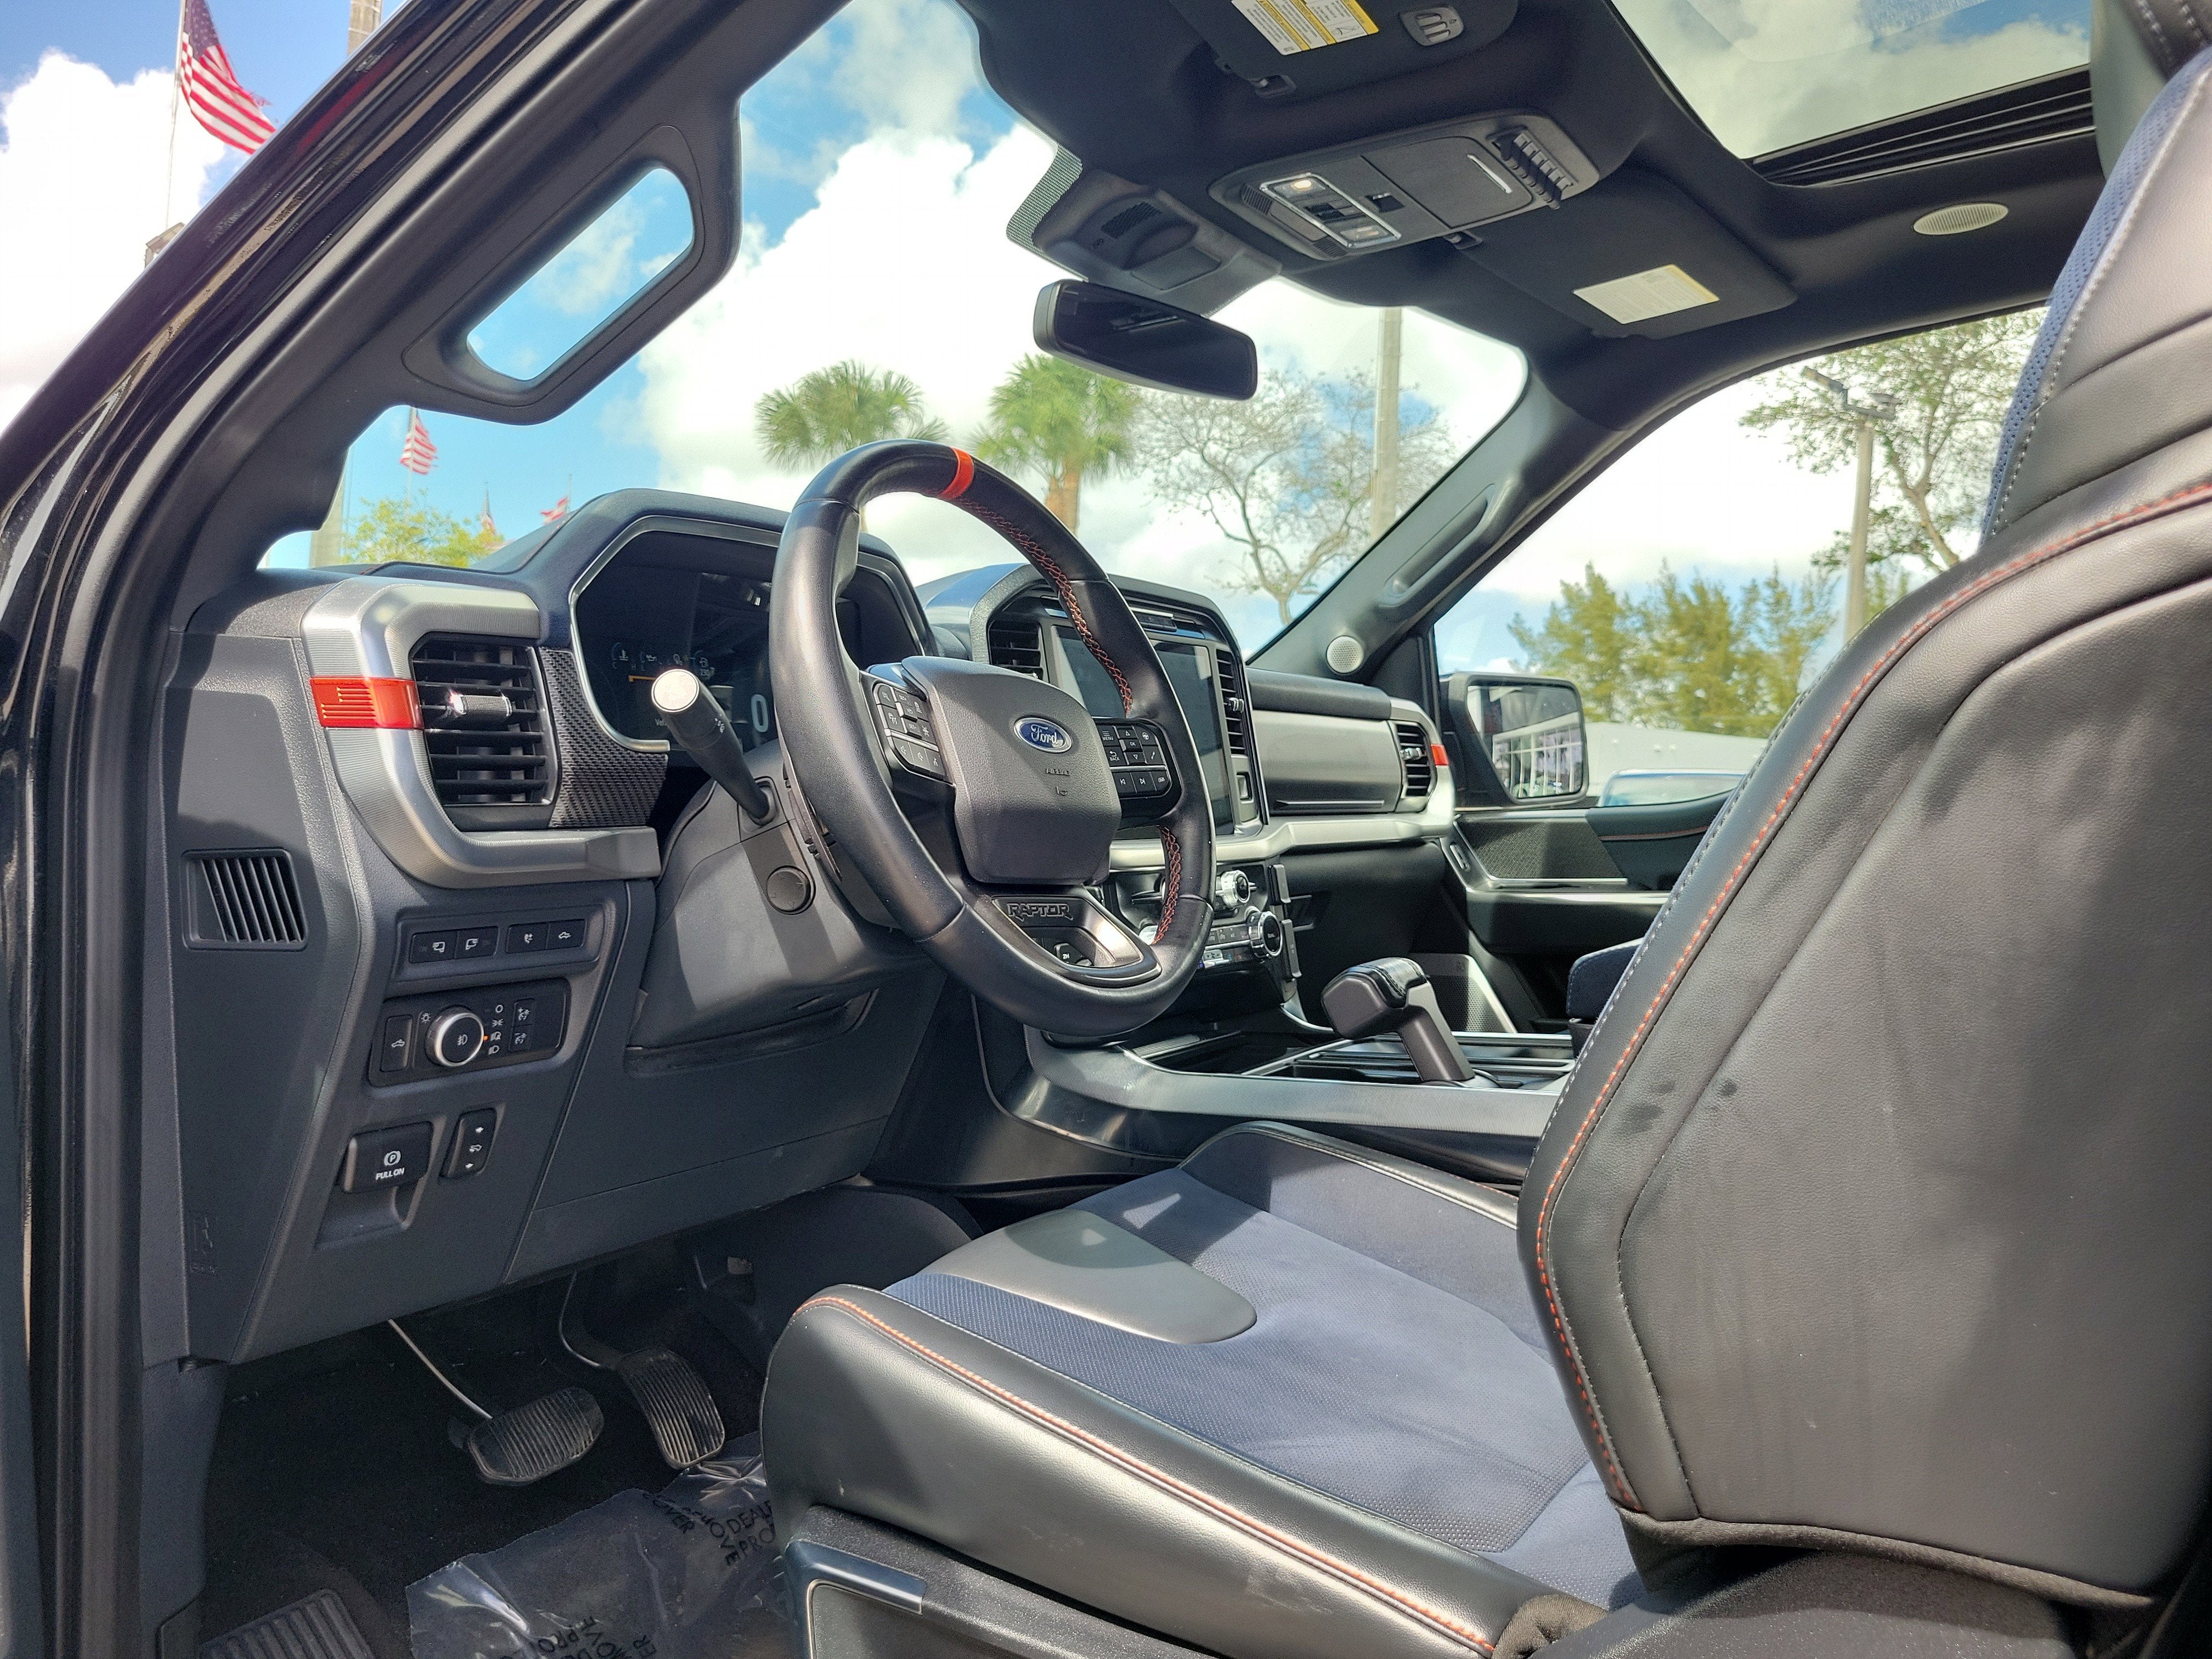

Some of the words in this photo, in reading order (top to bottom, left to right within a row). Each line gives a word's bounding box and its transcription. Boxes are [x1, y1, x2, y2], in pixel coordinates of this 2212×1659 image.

[1030, 724, 1060, 744] Ford
[1046, 768, 1071, 777] AIRBAG
[1006, 902, 1074, 922] RAPTOR
[375, 1170, 394, 1181] PULL
[393, 1167, 405, 1176] ON
